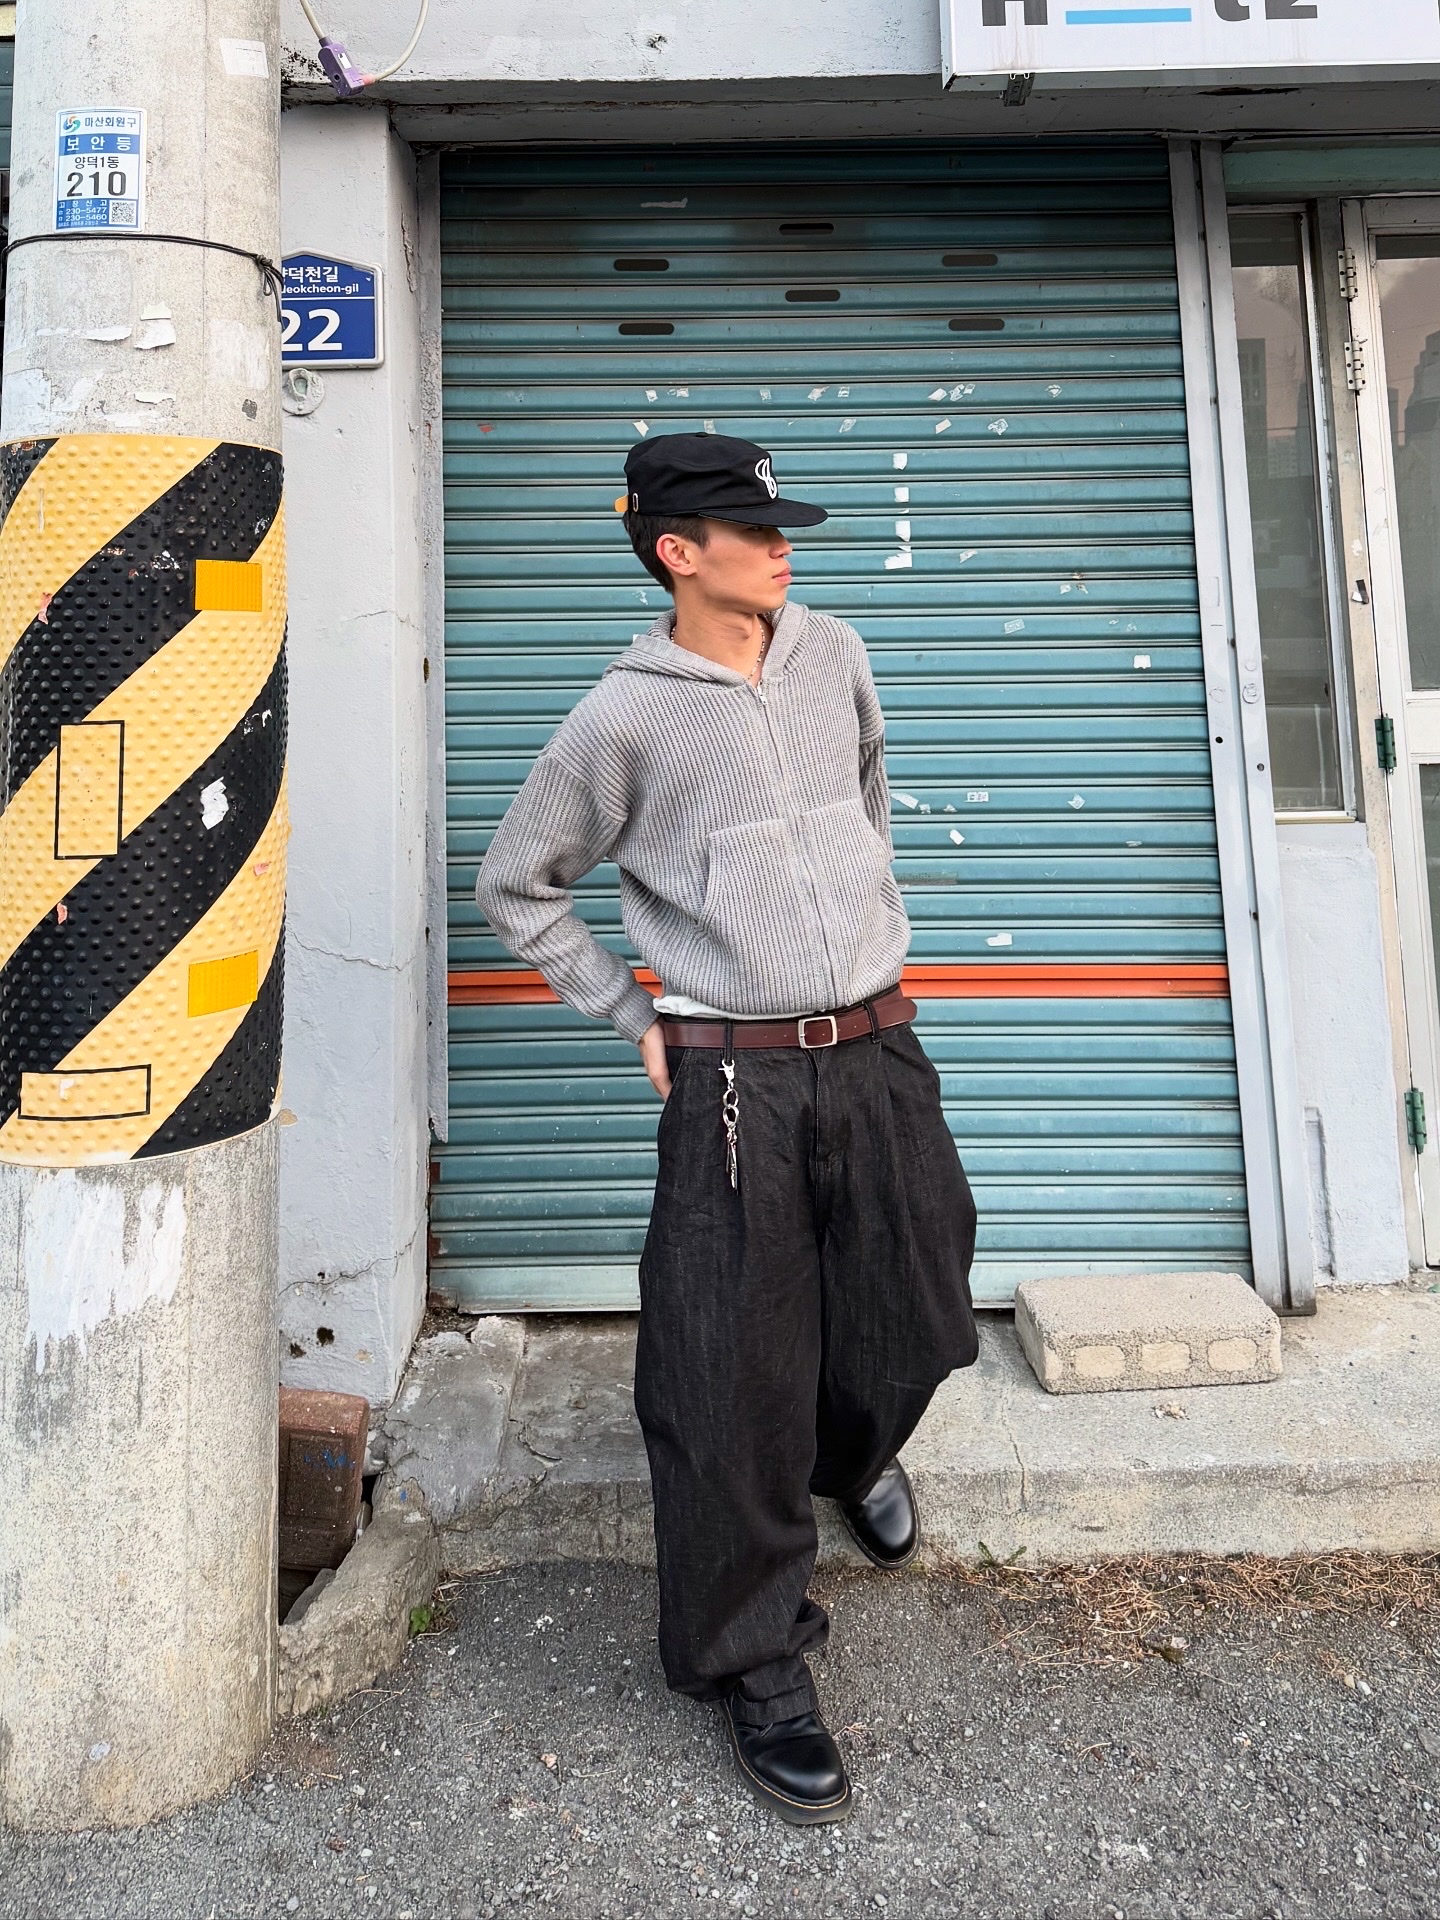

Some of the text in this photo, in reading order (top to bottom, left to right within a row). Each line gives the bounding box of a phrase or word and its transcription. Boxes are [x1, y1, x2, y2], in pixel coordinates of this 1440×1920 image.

[85, 117, 136, 128] 마산회원구
[75, 156, 119, 169] 양덕1동
[67, 171, 126, 197] 210
[65, 206, 107, 215] 230-5477
[281, 308, 342, 351] 22
